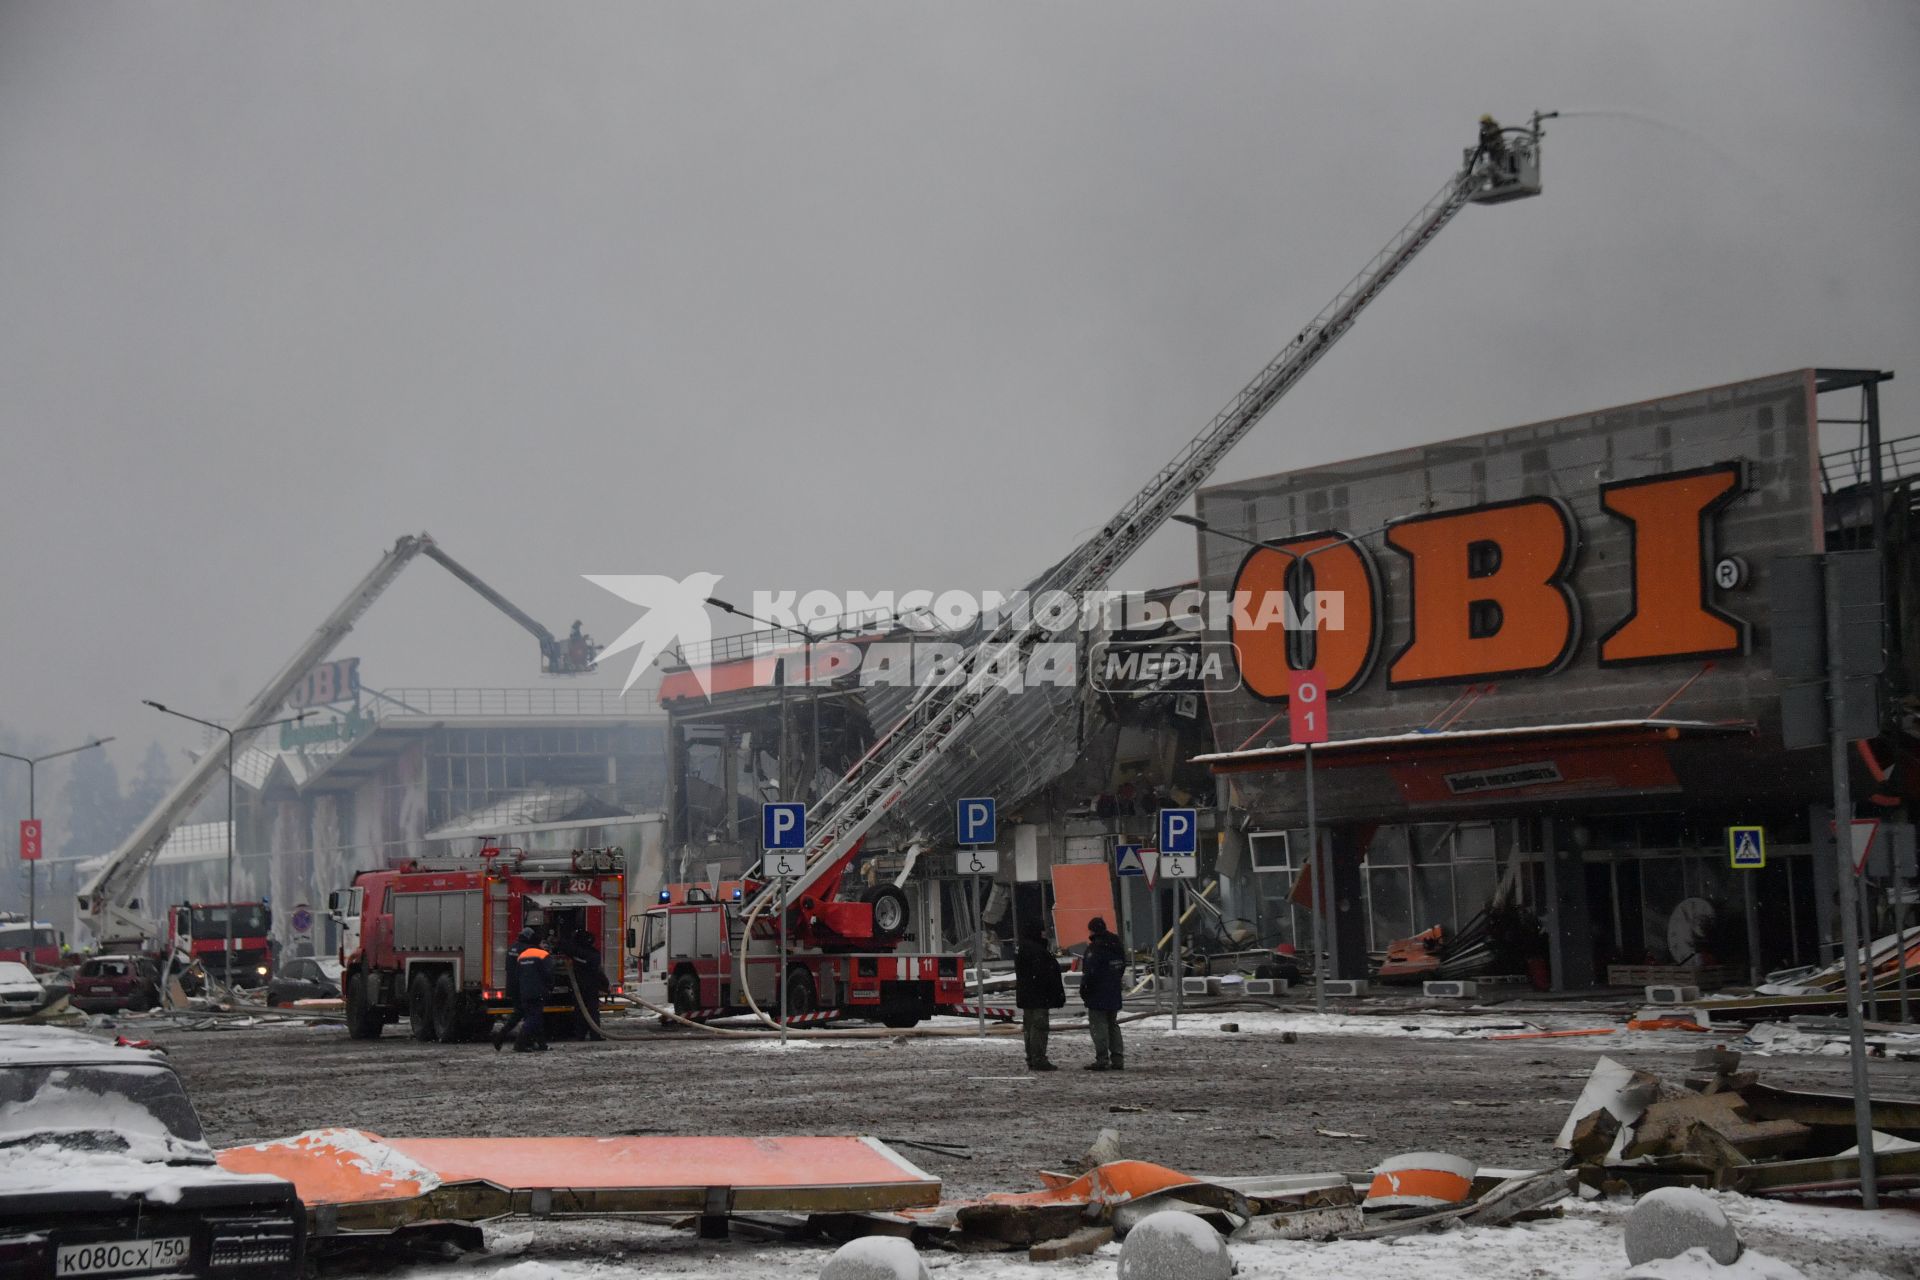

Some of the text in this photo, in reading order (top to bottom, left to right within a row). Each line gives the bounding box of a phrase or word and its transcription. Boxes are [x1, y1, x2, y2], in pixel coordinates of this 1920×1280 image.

[1231, 462, 1750, 702] OBI
[1304, 711, 1314, 731] 1
[773, 808, 794, 845] P
[968, 803, 988, 838] P
[1168, 814, 1188, 847] P
[569, 878, 594, 892] 267
[923, 958, 932, 972] 11
[154, 1239, 184, 1258] 750
